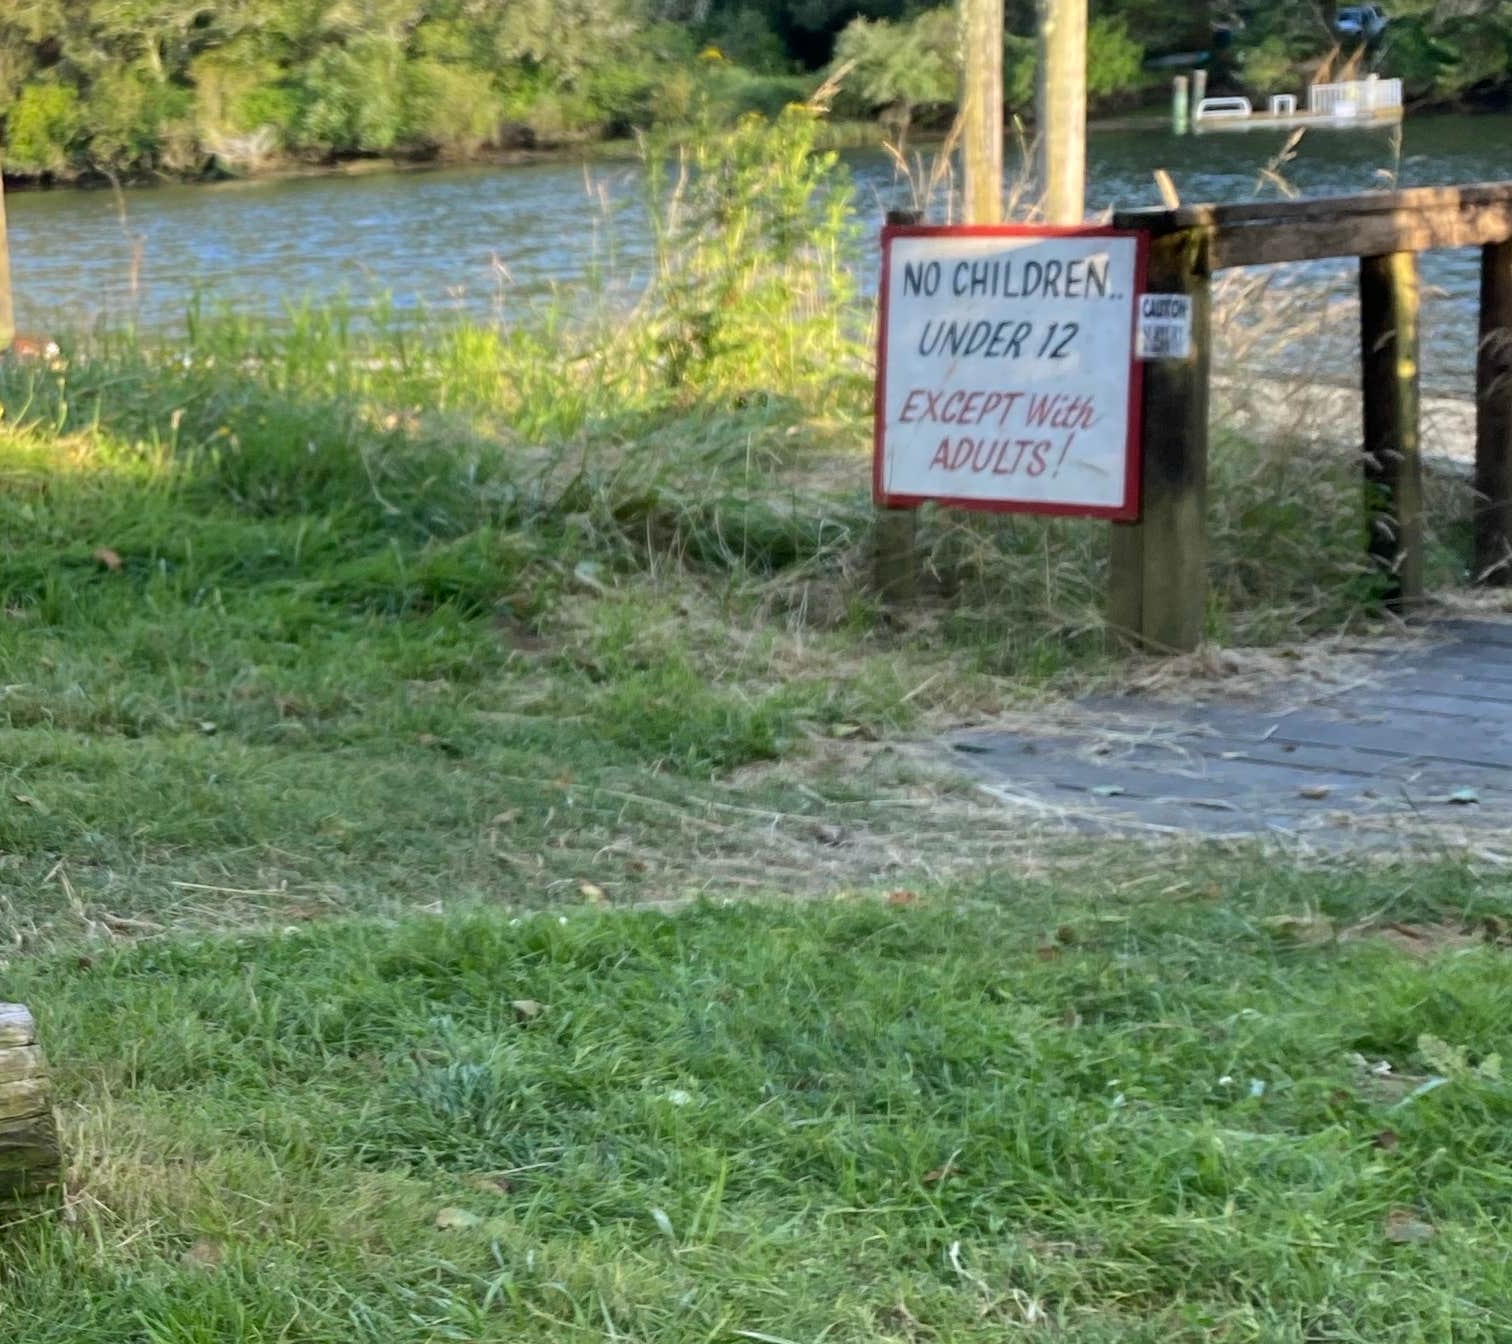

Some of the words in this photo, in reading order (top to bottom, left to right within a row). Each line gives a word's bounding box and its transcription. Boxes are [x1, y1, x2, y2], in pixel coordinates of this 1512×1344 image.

[902, 261, 942, 298] NO
[918, 320, 1032, 359] UNDER
[1037, 321, 1080, 359] 12
[898, 389, 1025, 425] EXCEPT
[1025, 392, 1097, 430] With
